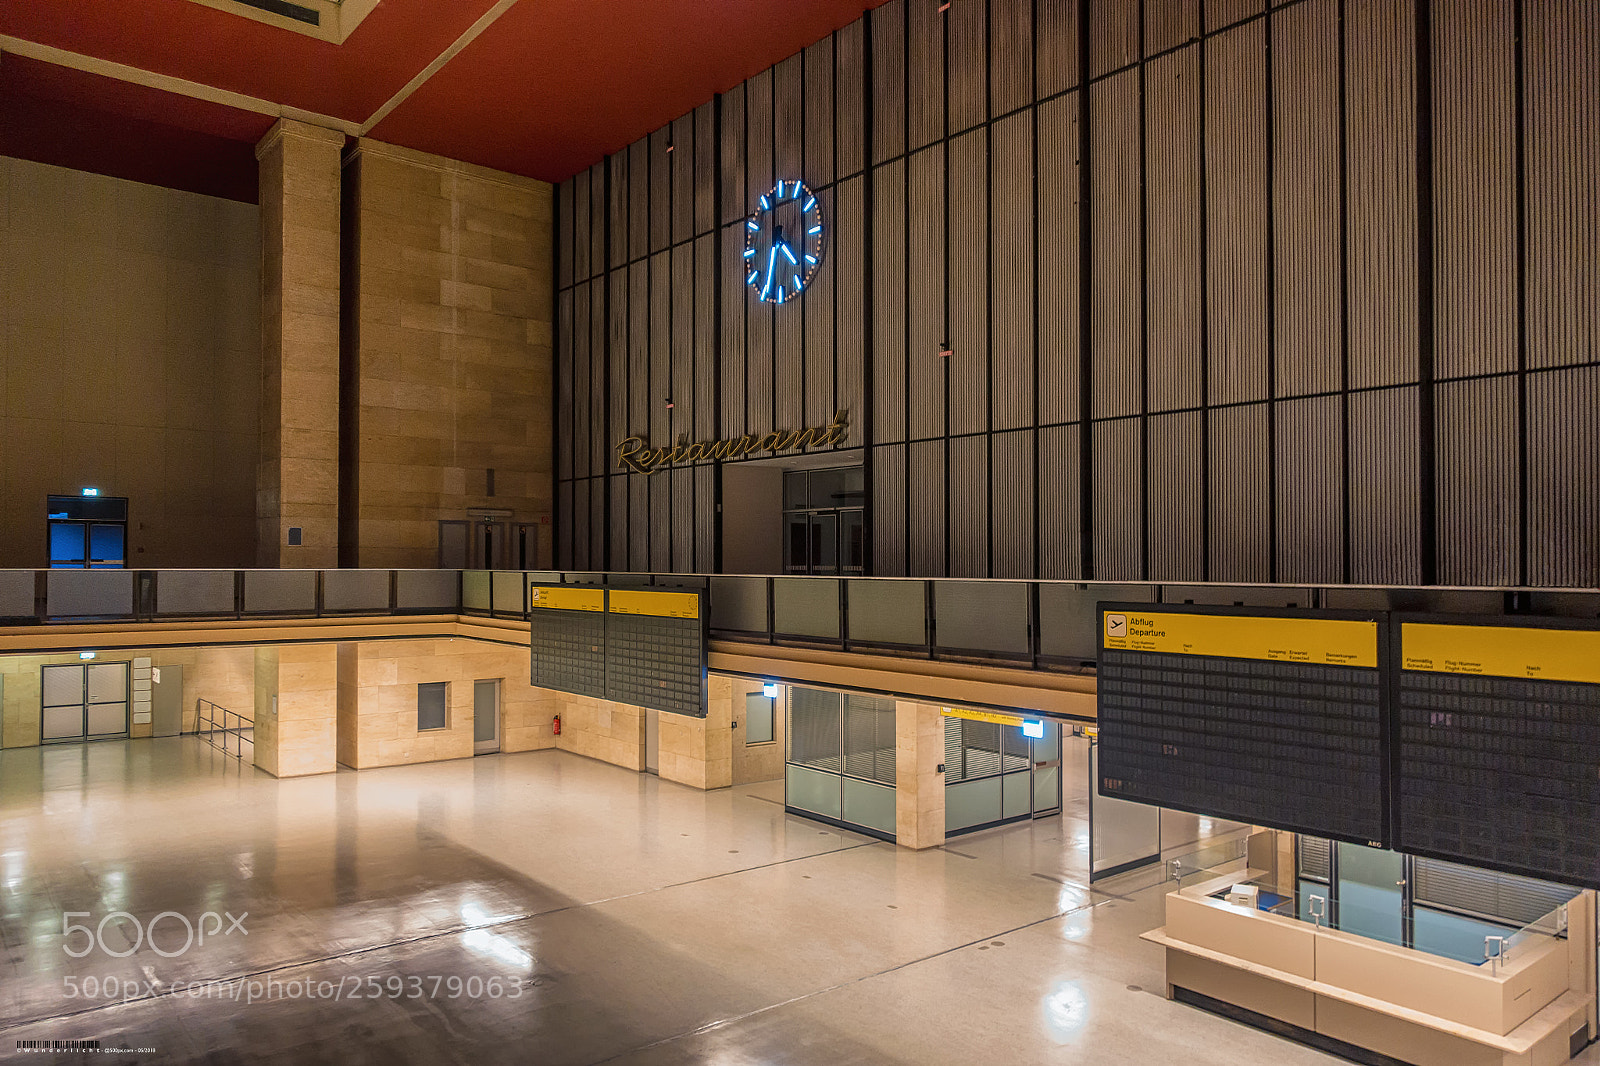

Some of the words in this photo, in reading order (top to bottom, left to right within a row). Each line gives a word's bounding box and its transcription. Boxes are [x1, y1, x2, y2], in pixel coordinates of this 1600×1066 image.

[615, 409, 849, 475] Restaurant
[1130, 617, 1154, 627] Abflug
[1130, 628, 1166, 638] Departure
[1367, 840, 1382, 848] AEG
